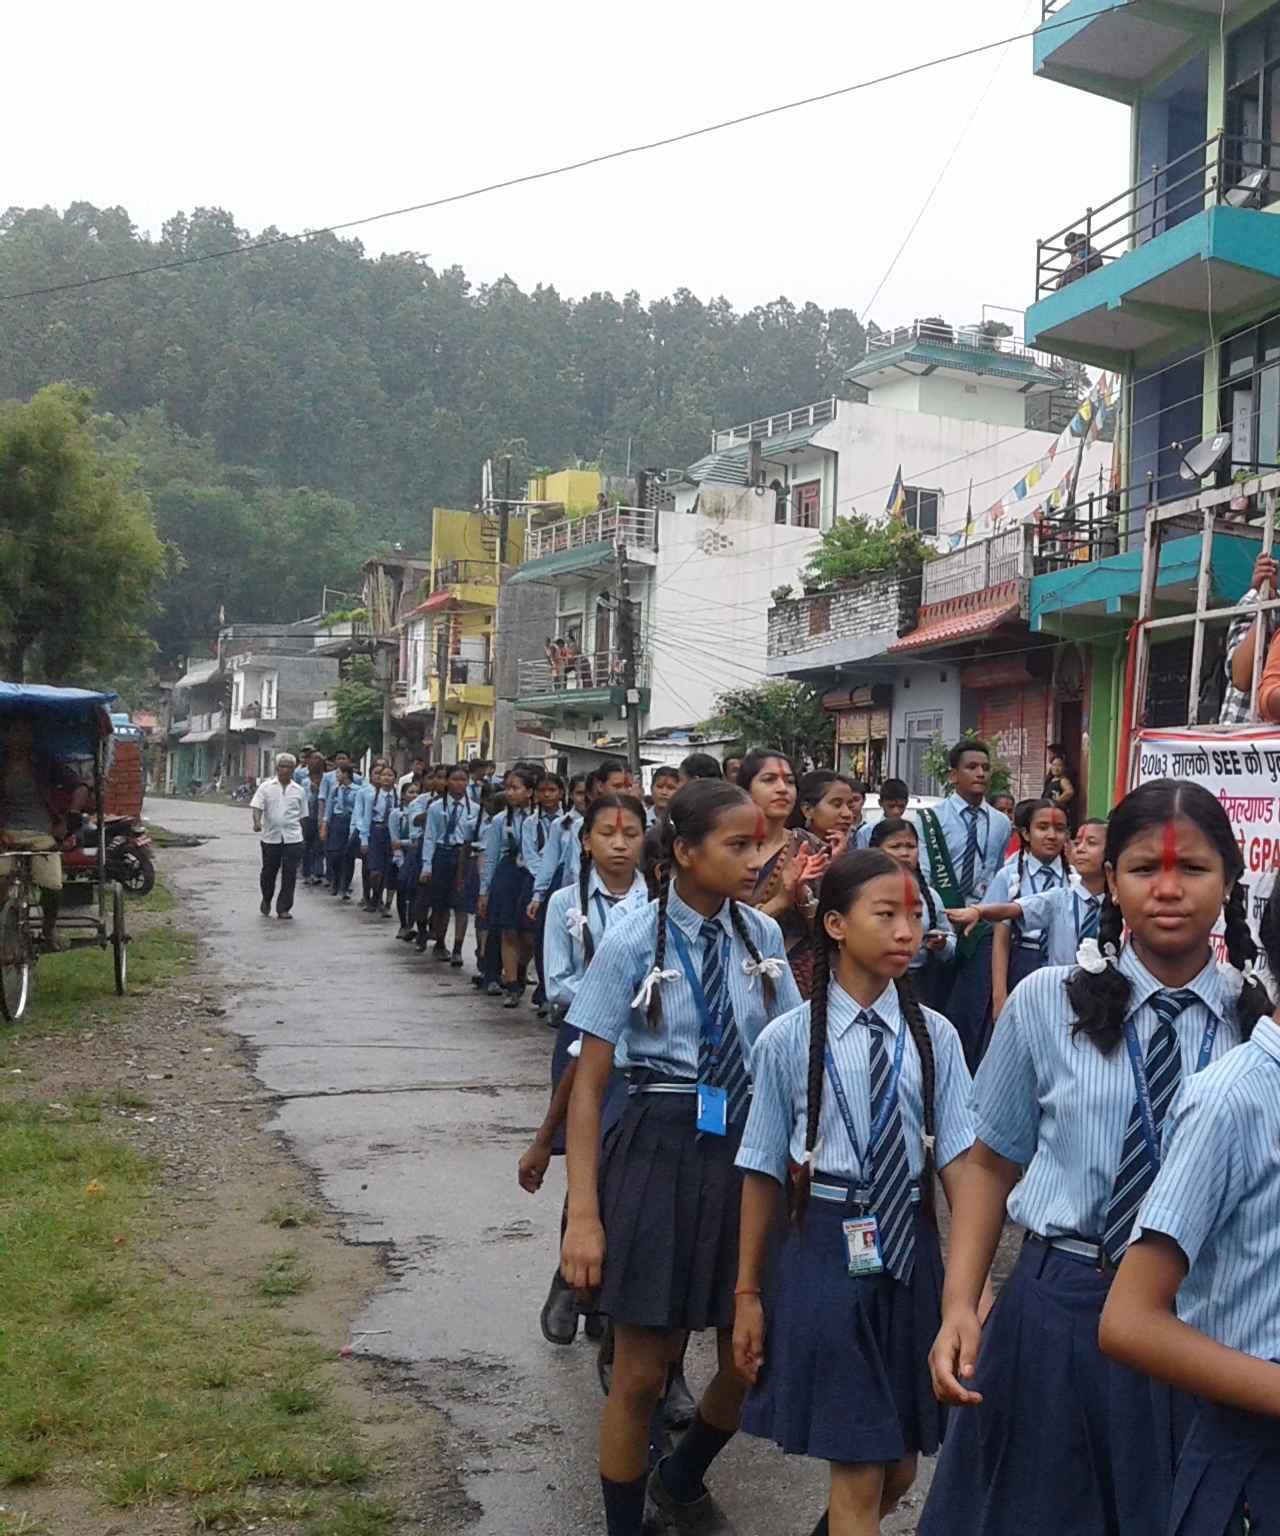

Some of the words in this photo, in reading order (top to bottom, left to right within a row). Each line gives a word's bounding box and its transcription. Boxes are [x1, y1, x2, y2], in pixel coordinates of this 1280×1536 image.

[1141, 752, 1168, 779] २०७३
[1172, 745, 1210, 776] सालको
[1213, 750, 1242, 775] SEE
[1244, 743, 1263, 775] को
